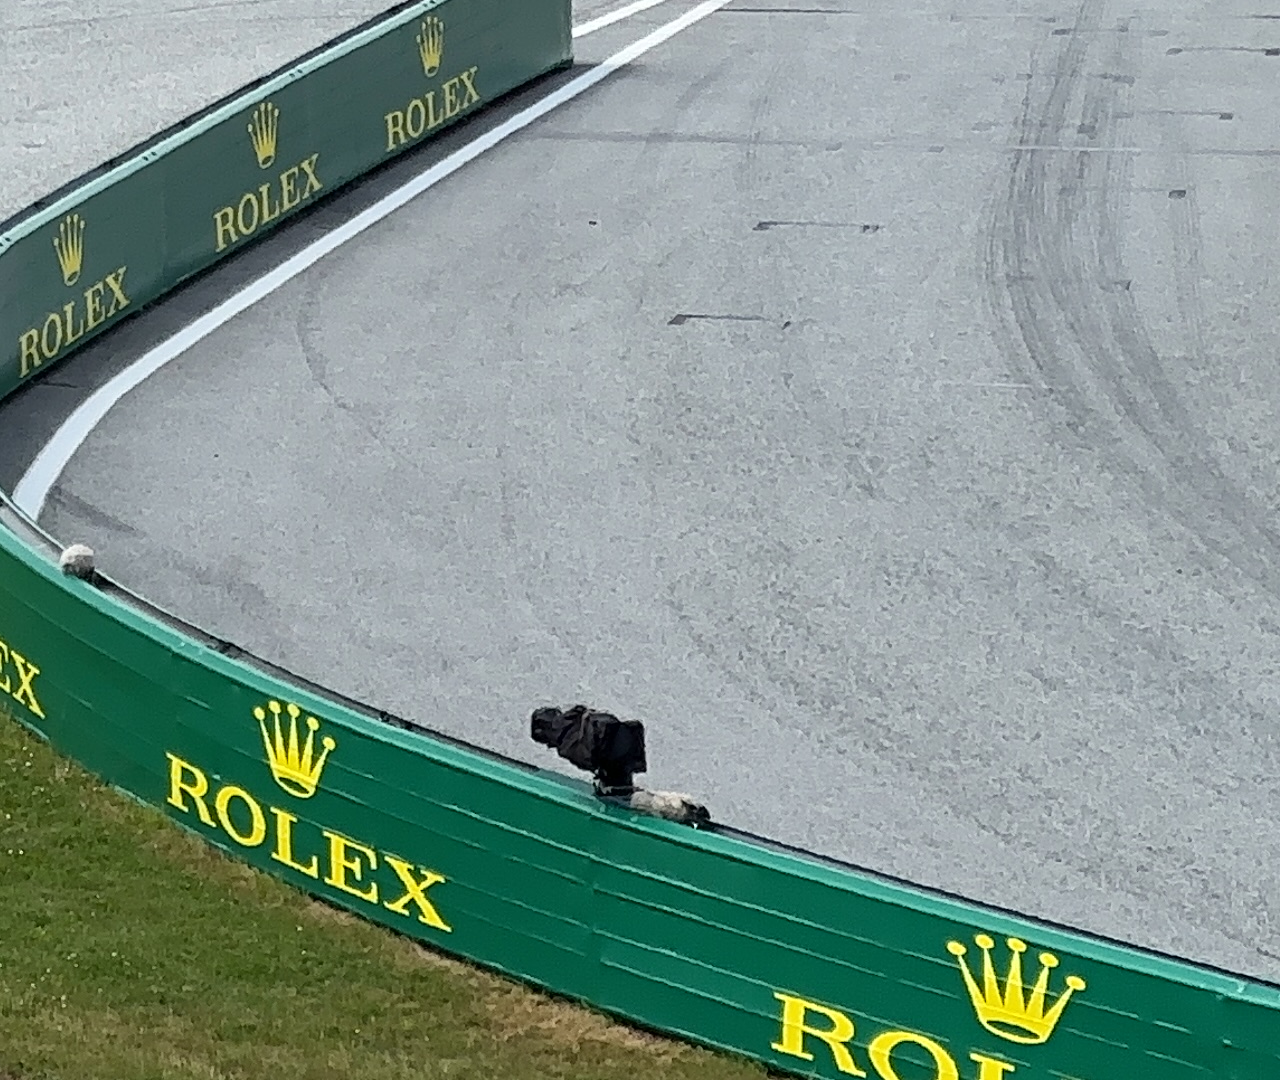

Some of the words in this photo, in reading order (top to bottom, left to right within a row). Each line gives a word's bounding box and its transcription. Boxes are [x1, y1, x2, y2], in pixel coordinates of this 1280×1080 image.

[384, 65, 481, 152] ROLEX
[213, 153, 323, 252] ROLEX
[17, 266, 131, 379] ROLEX
[165, 752, 453, 933] ROLEX
